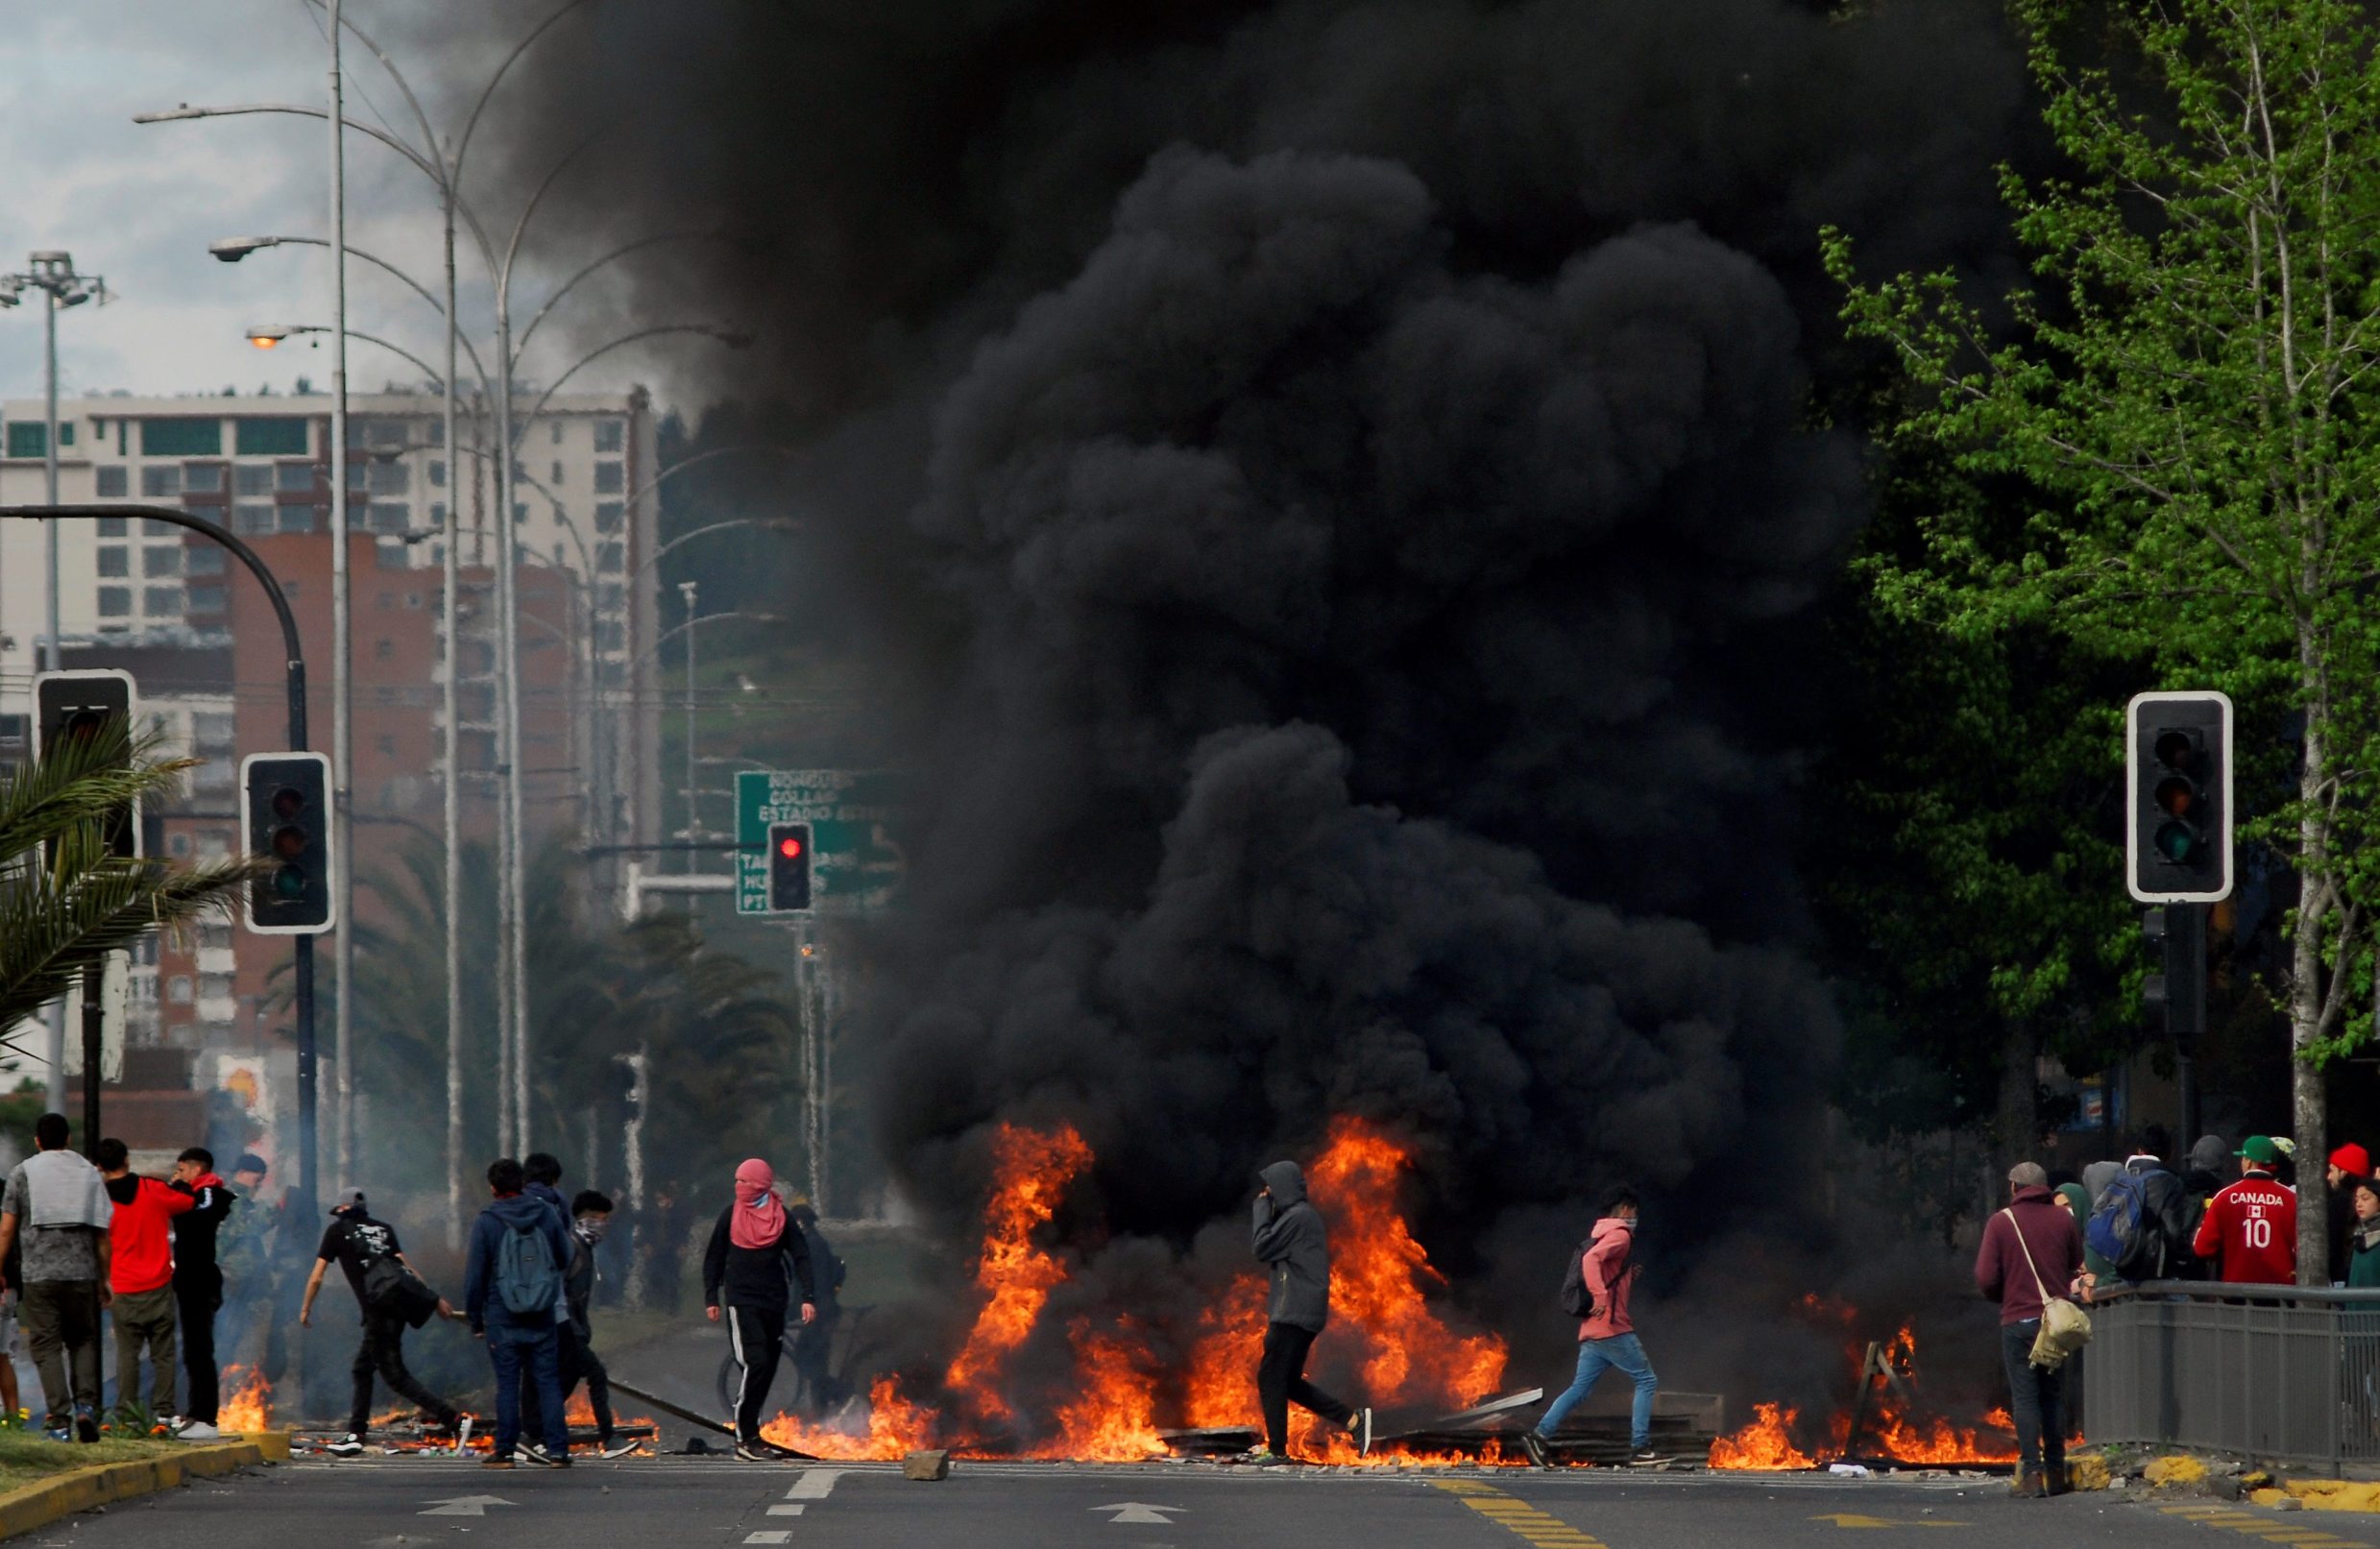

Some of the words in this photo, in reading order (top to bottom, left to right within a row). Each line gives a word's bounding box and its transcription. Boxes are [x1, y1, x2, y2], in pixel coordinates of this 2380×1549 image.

[759, 805, 831, 821] ESTADIO
[2229, 1192, 2284, 1206] CANADA
[2243, 1219, 2271, 1248] 10
